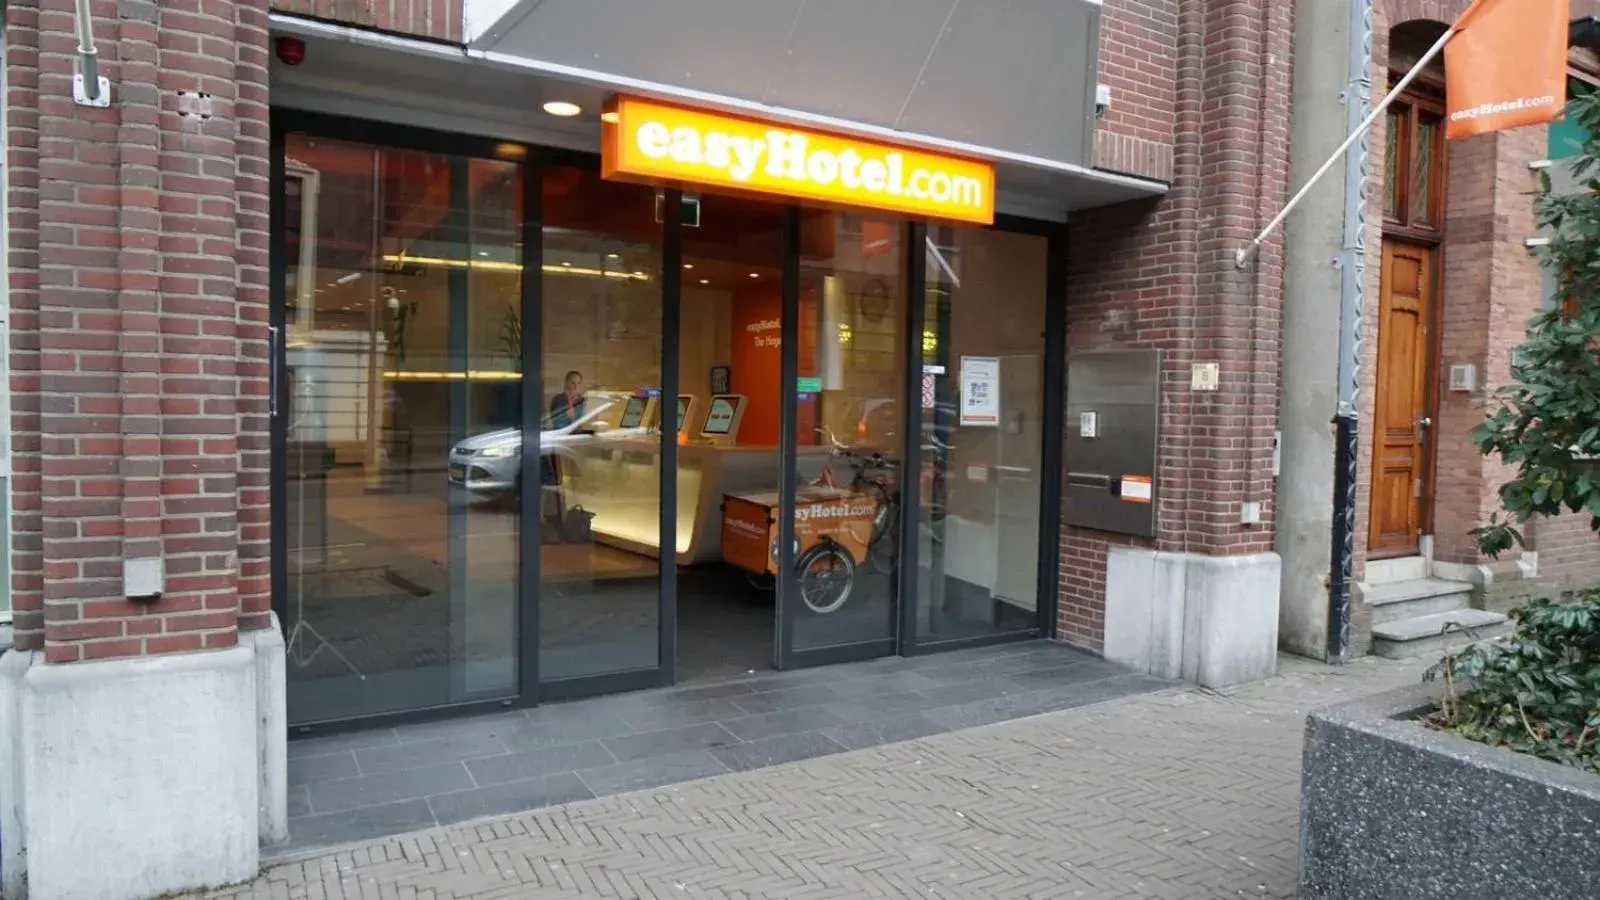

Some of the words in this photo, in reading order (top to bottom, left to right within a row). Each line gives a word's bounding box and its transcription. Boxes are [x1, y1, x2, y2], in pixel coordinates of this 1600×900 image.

[1450, 95, 1554, 121] easyHotel.com
[636, 121, 983, 207] easyHotel.com
[795, 503, 875, 521] syHotel.com
